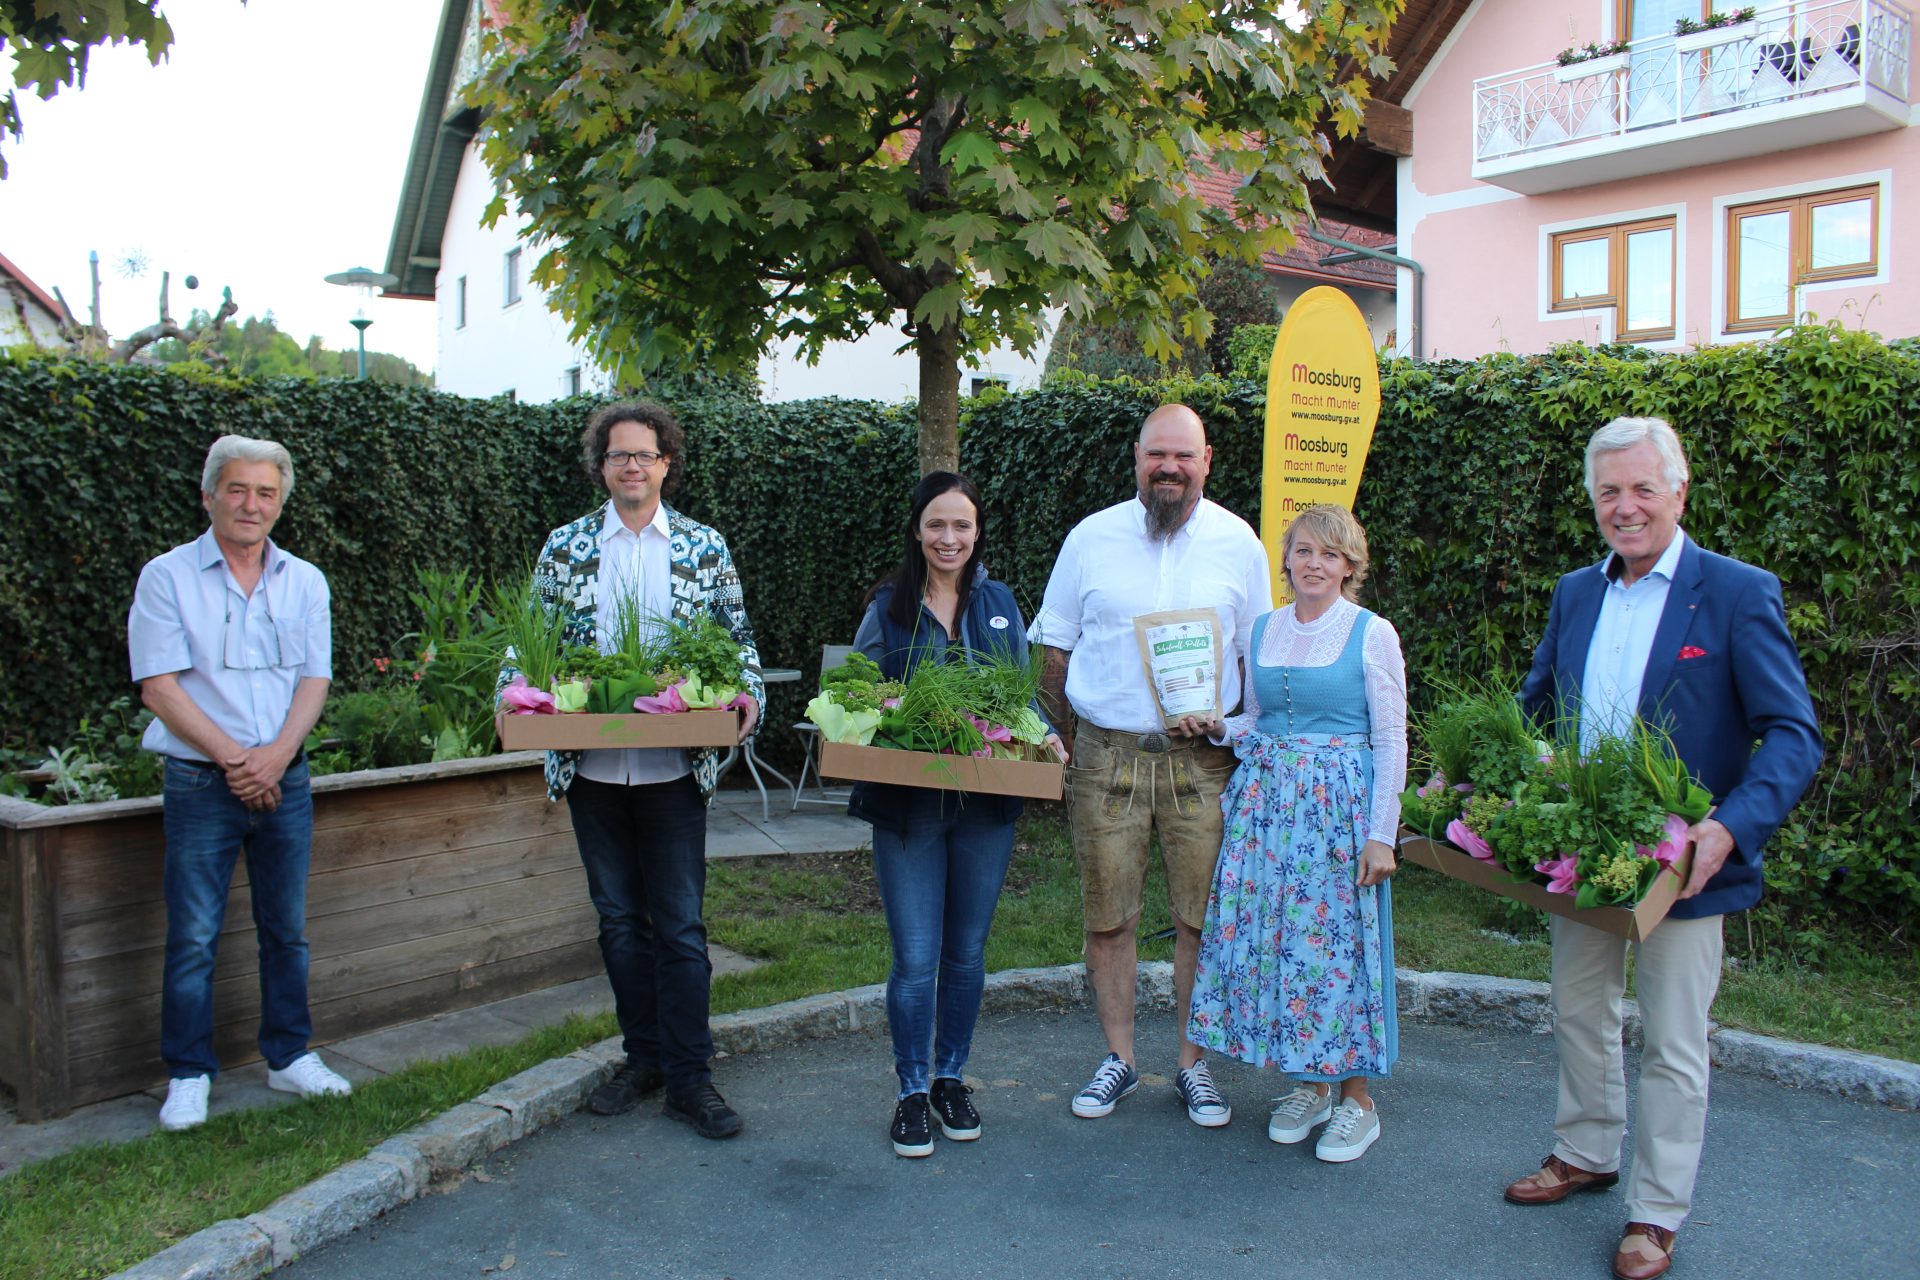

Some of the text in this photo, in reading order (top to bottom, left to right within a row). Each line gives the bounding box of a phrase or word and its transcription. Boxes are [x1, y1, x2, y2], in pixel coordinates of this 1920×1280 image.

[1292, 363, 1361, 394] Moosburg
[1292, 393, 1360, 411] Macht Munter
[1291, 411, 1360, 425] www.moosburg.gv.at
[1284, 432, 1348, 458] Moosburg
[1284, 459, 1347, 474] Macht Munter
[1284, 476, 1347, 487] www.moosburg.gv.at
